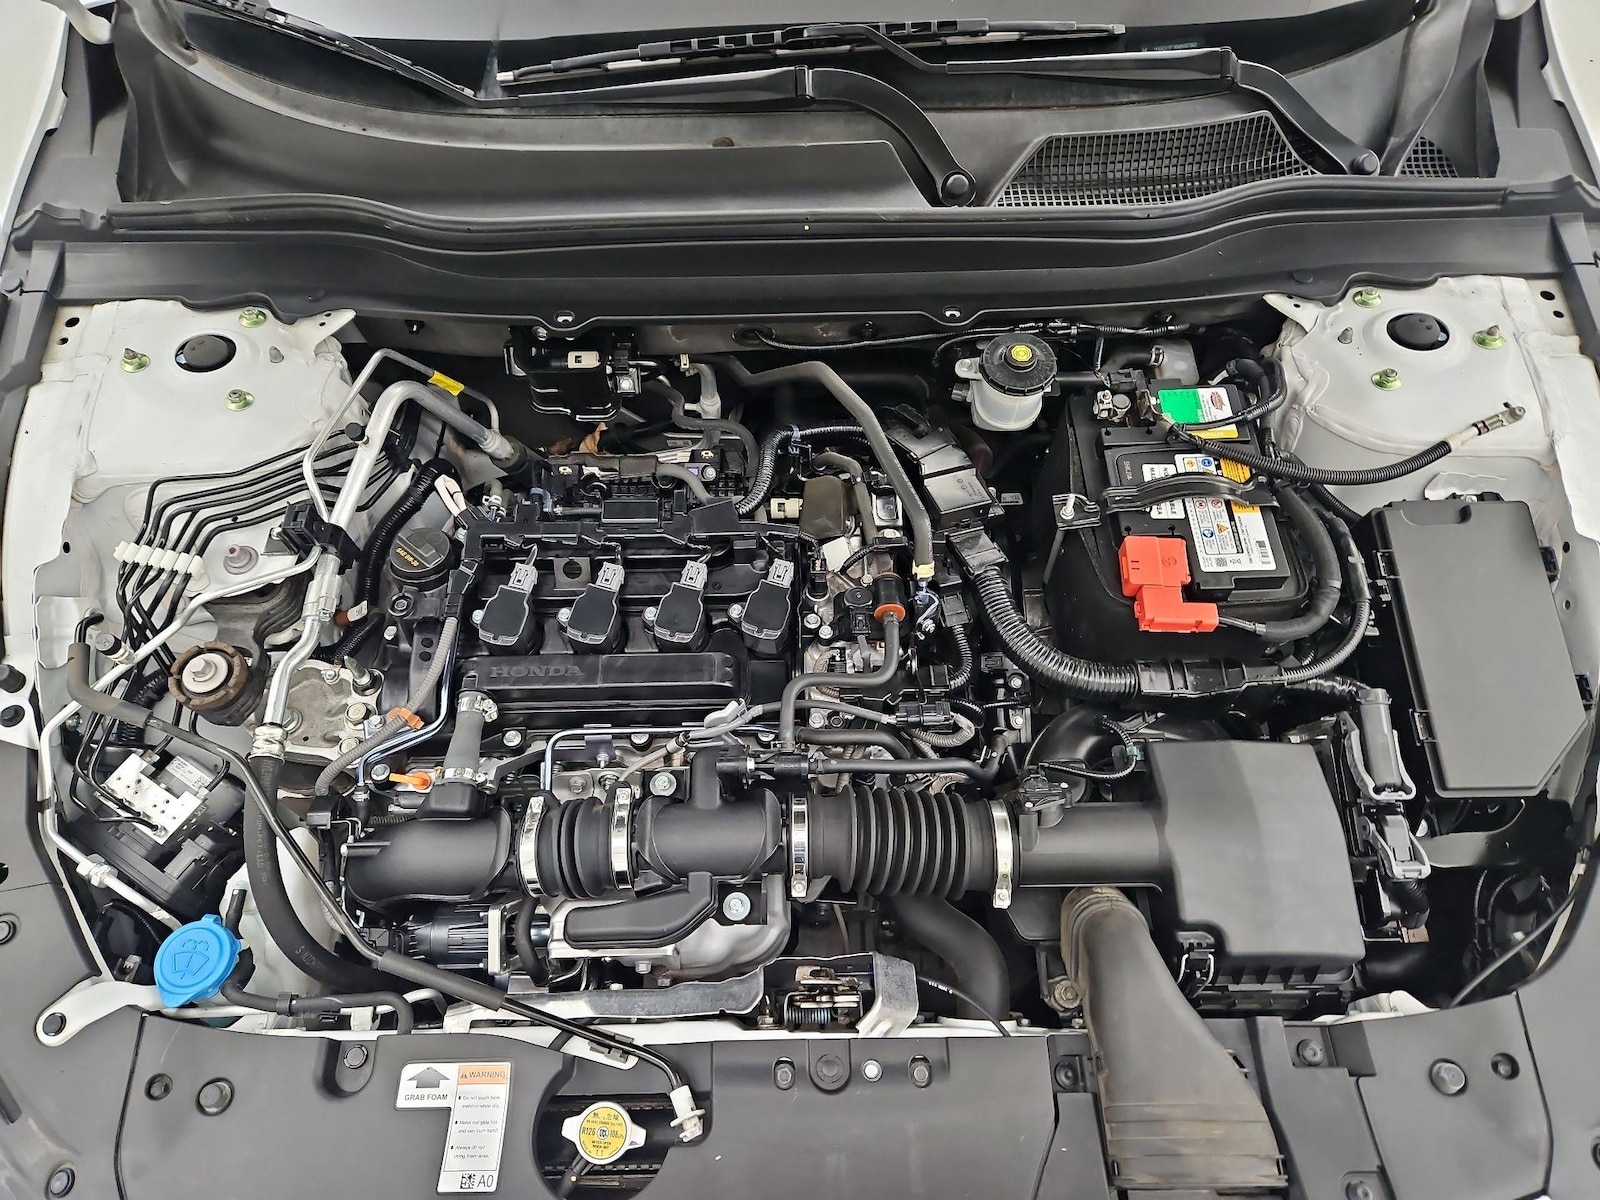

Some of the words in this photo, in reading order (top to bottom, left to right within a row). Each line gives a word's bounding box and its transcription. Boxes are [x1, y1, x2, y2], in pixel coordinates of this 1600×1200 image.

[395, 547, 408, 557] SAE
[489, 665, 584, 678] HONDA
[469, 1071, 506, 1079] WARNING
[426, 1093, 449, 1101] FOAM
[477, 1174, 494, 1188] A0
